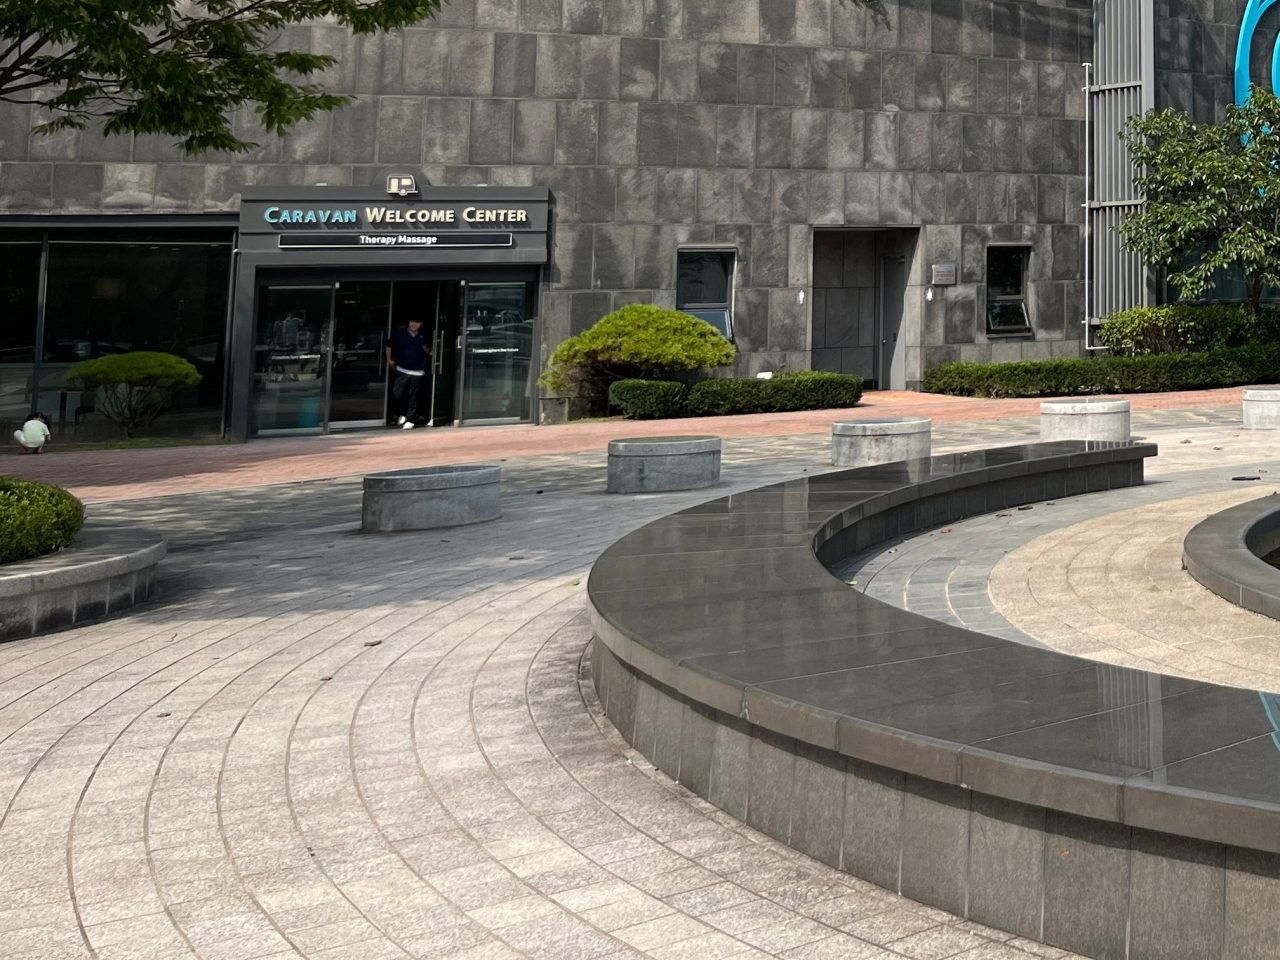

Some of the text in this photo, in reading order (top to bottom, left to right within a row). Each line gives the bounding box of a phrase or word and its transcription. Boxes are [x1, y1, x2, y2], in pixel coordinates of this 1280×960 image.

[264, 206, 527, 223] CARAVAN WELCOME CENTER
[360, 235, 437, 245] Therapy Massage
